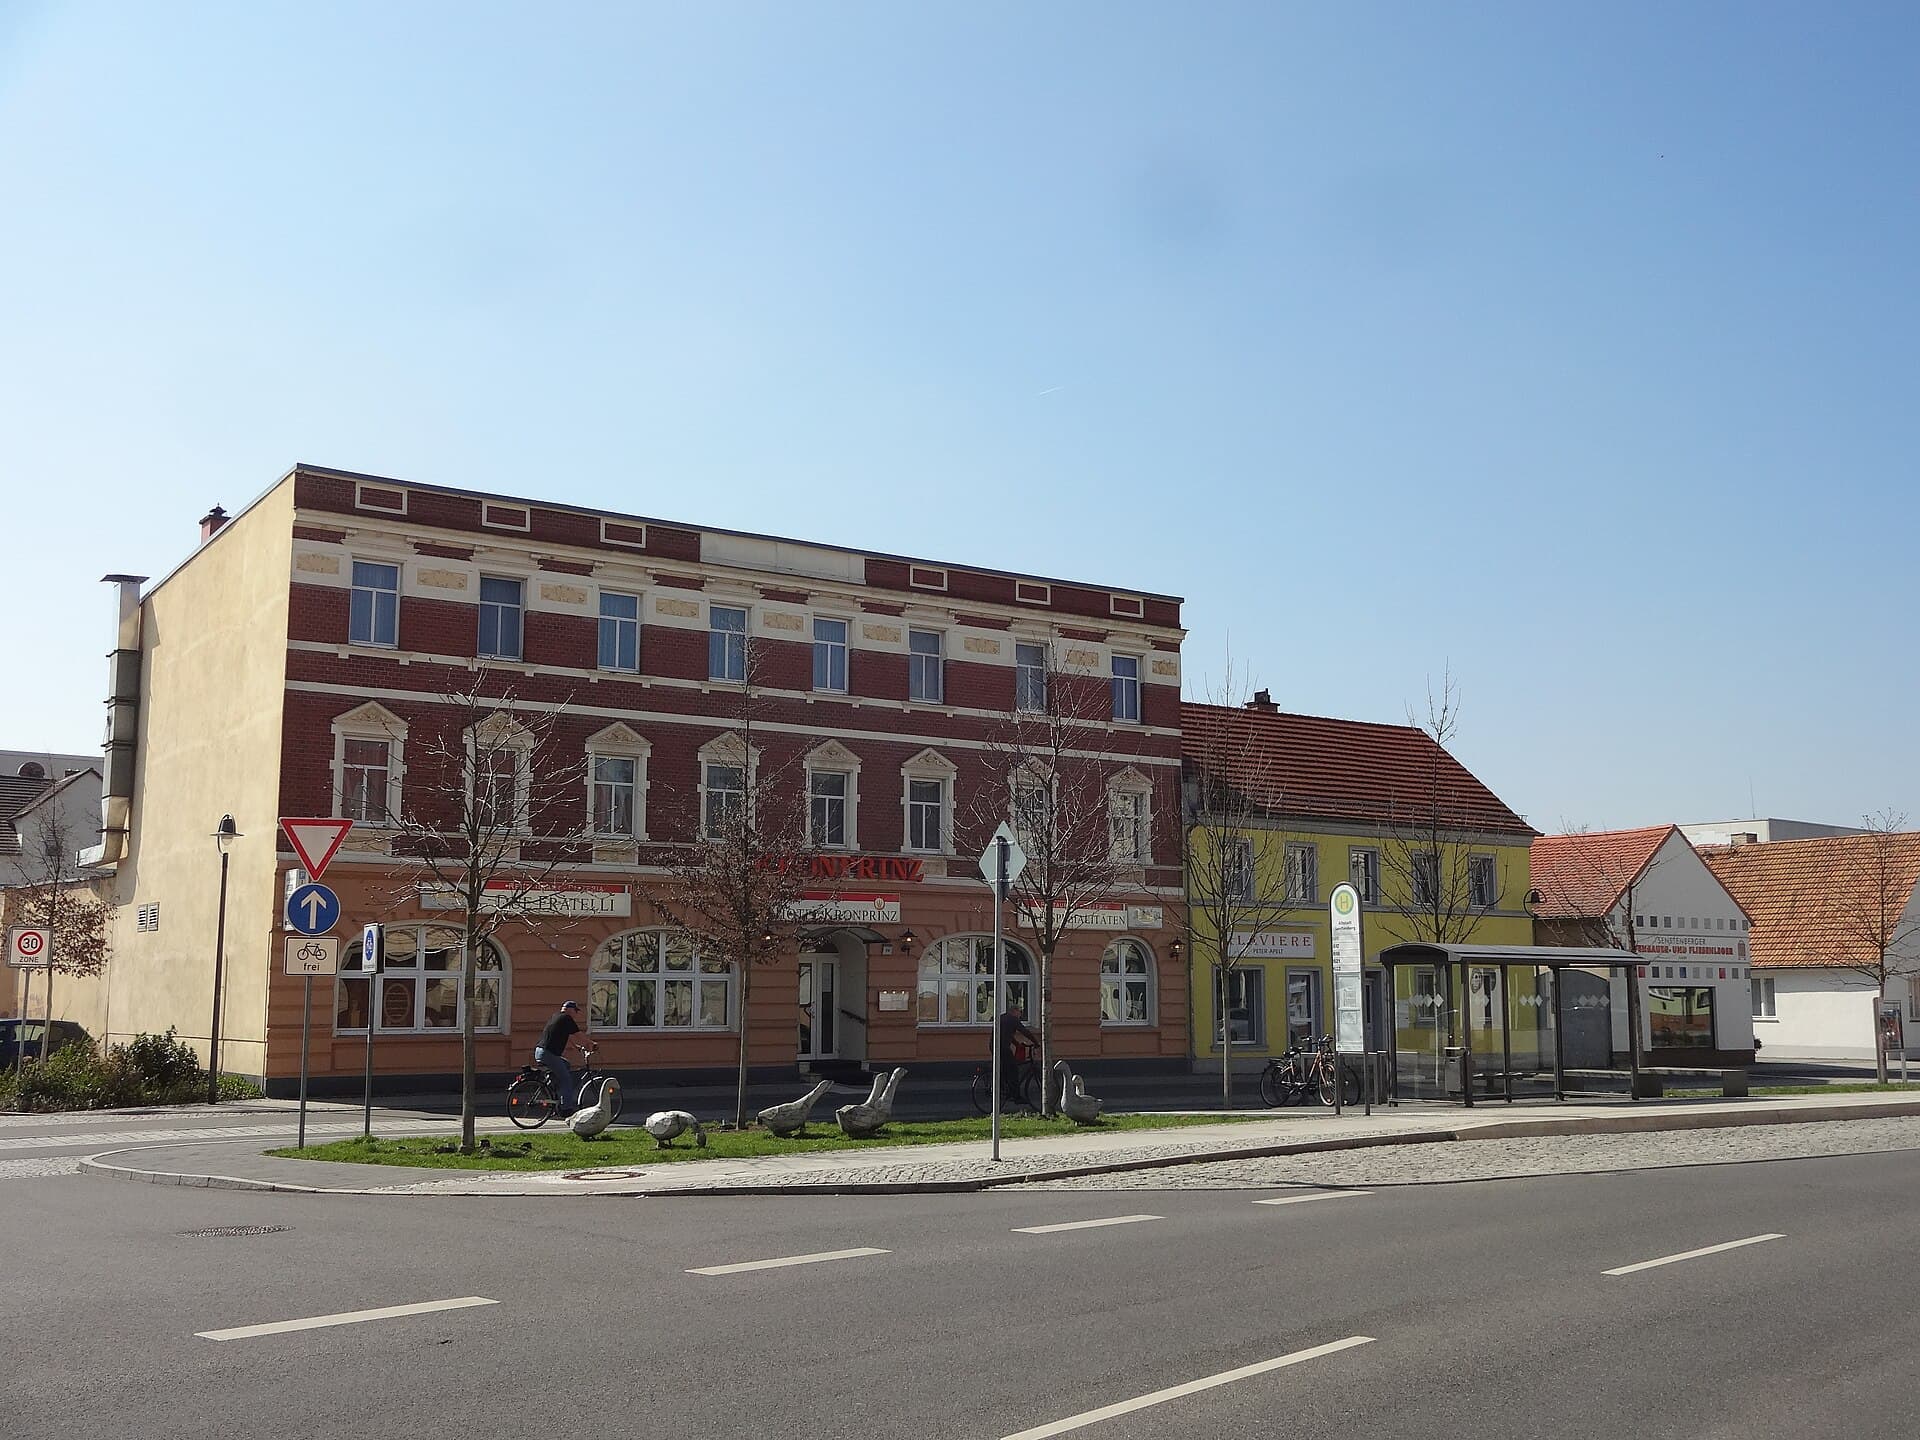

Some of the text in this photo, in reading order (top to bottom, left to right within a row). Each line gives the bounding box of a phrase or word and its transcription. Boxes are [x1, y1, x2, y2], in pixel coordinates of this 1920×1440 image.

[538, 896, 615, 912] FRATELLI
[824, 907, 898, 922] KRONPRINZ
[22, 937, 38, 949] 30
[1672, 945, 1687, 954] UND
[303, 963, 321, 971] frei
